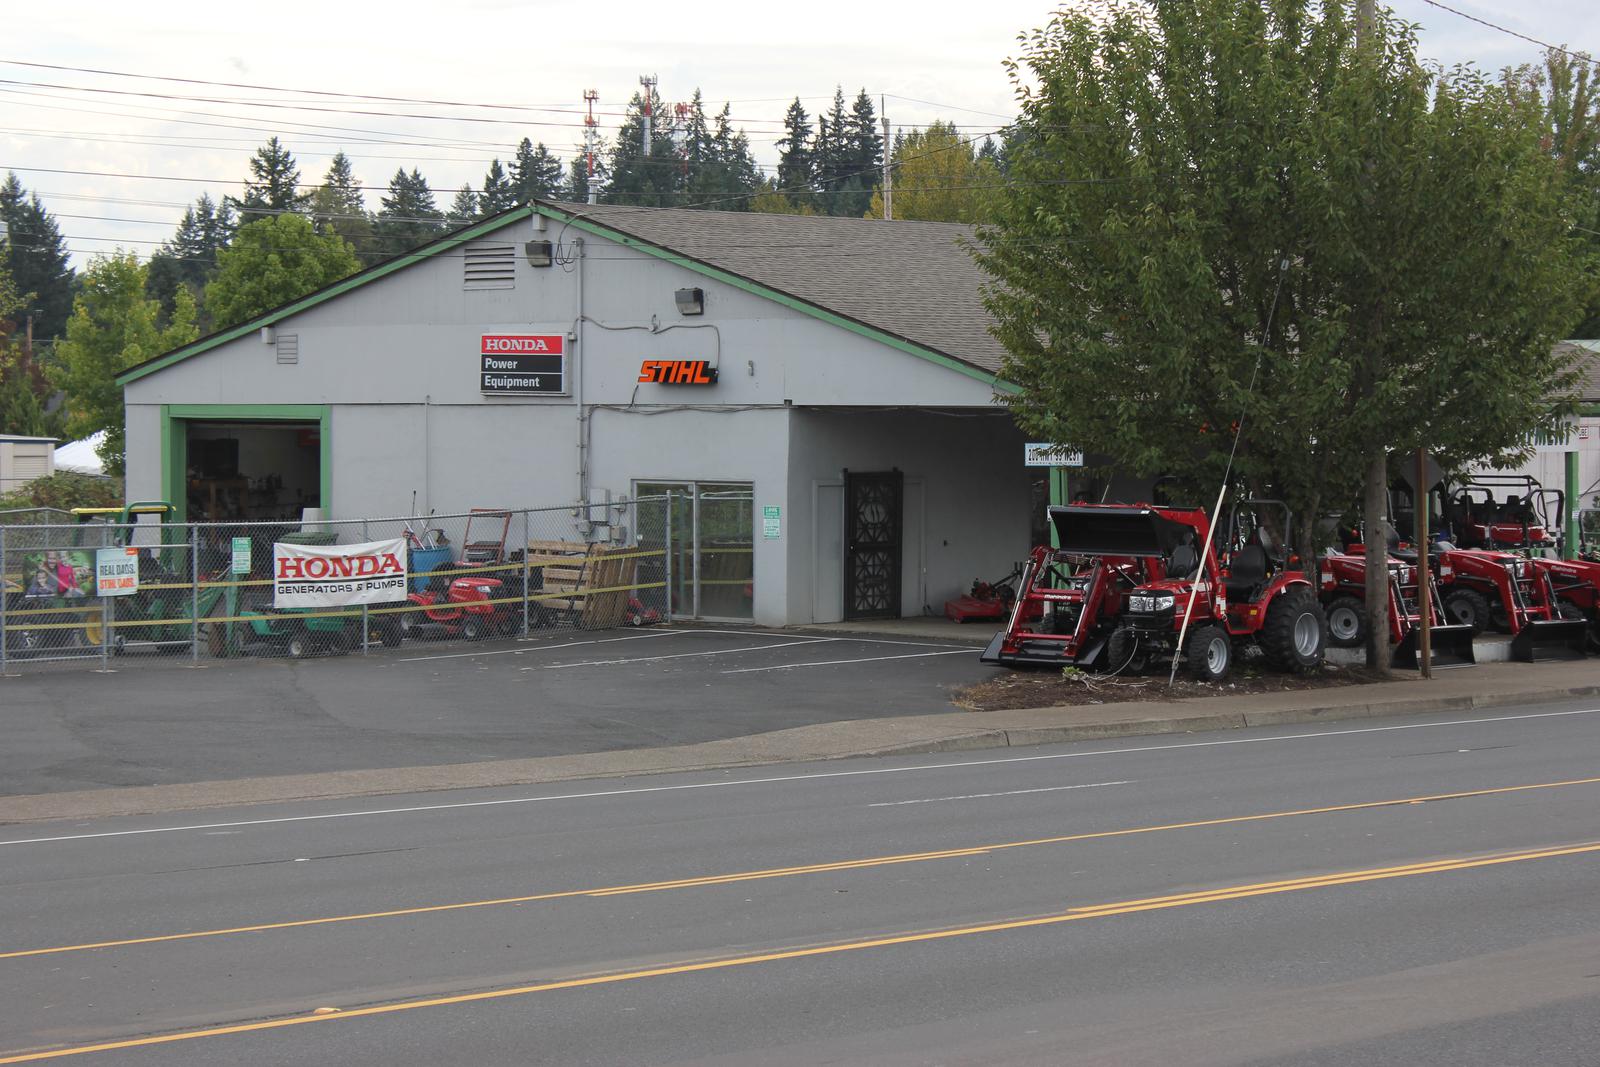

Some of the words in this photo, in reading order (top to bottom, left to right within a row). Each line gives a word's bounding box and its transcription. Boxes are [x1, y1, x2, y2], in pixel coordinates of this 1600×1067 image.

[485, 339, 548, 351] HONDA
[485, 358, 518, 369] Power
[638, 361, 710, 384] STIHL
[484, 375, 540, 389] Equipment
[277, 553, 403, 579] HONDA
[278, 584, 353, 595] GENERATORS
[366, 580, 404, 591] PUMPS
